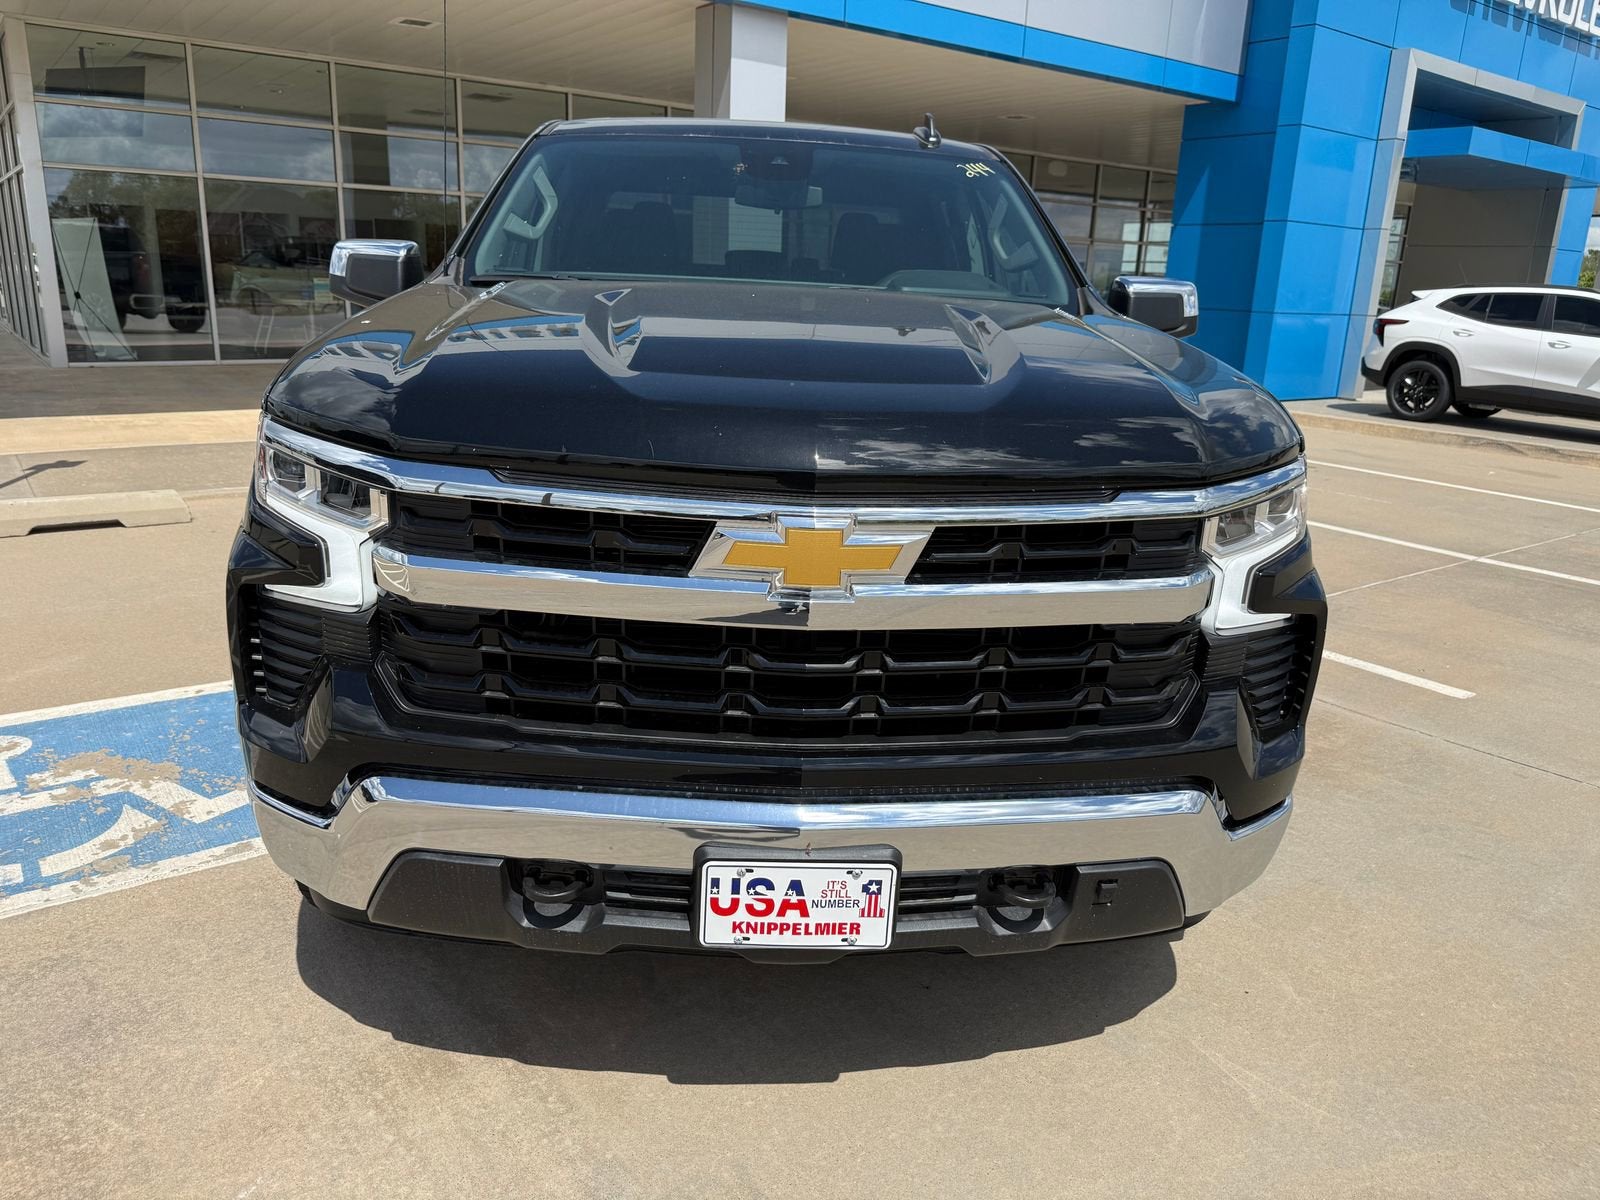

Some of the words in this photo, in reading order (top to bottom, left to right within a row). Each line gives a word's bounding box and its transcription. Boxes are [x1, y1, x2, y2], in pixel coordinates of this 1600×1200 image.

[826, 880, 848, 889] IT'S
[709, 877, 810, 918] USA
[811, 899, 860, 909] NUMBER
[859, 879, 885, 918] 1
[820, 889, 851, 899] STILL
[732, 921, 862, 936] KNIPPELMIER
